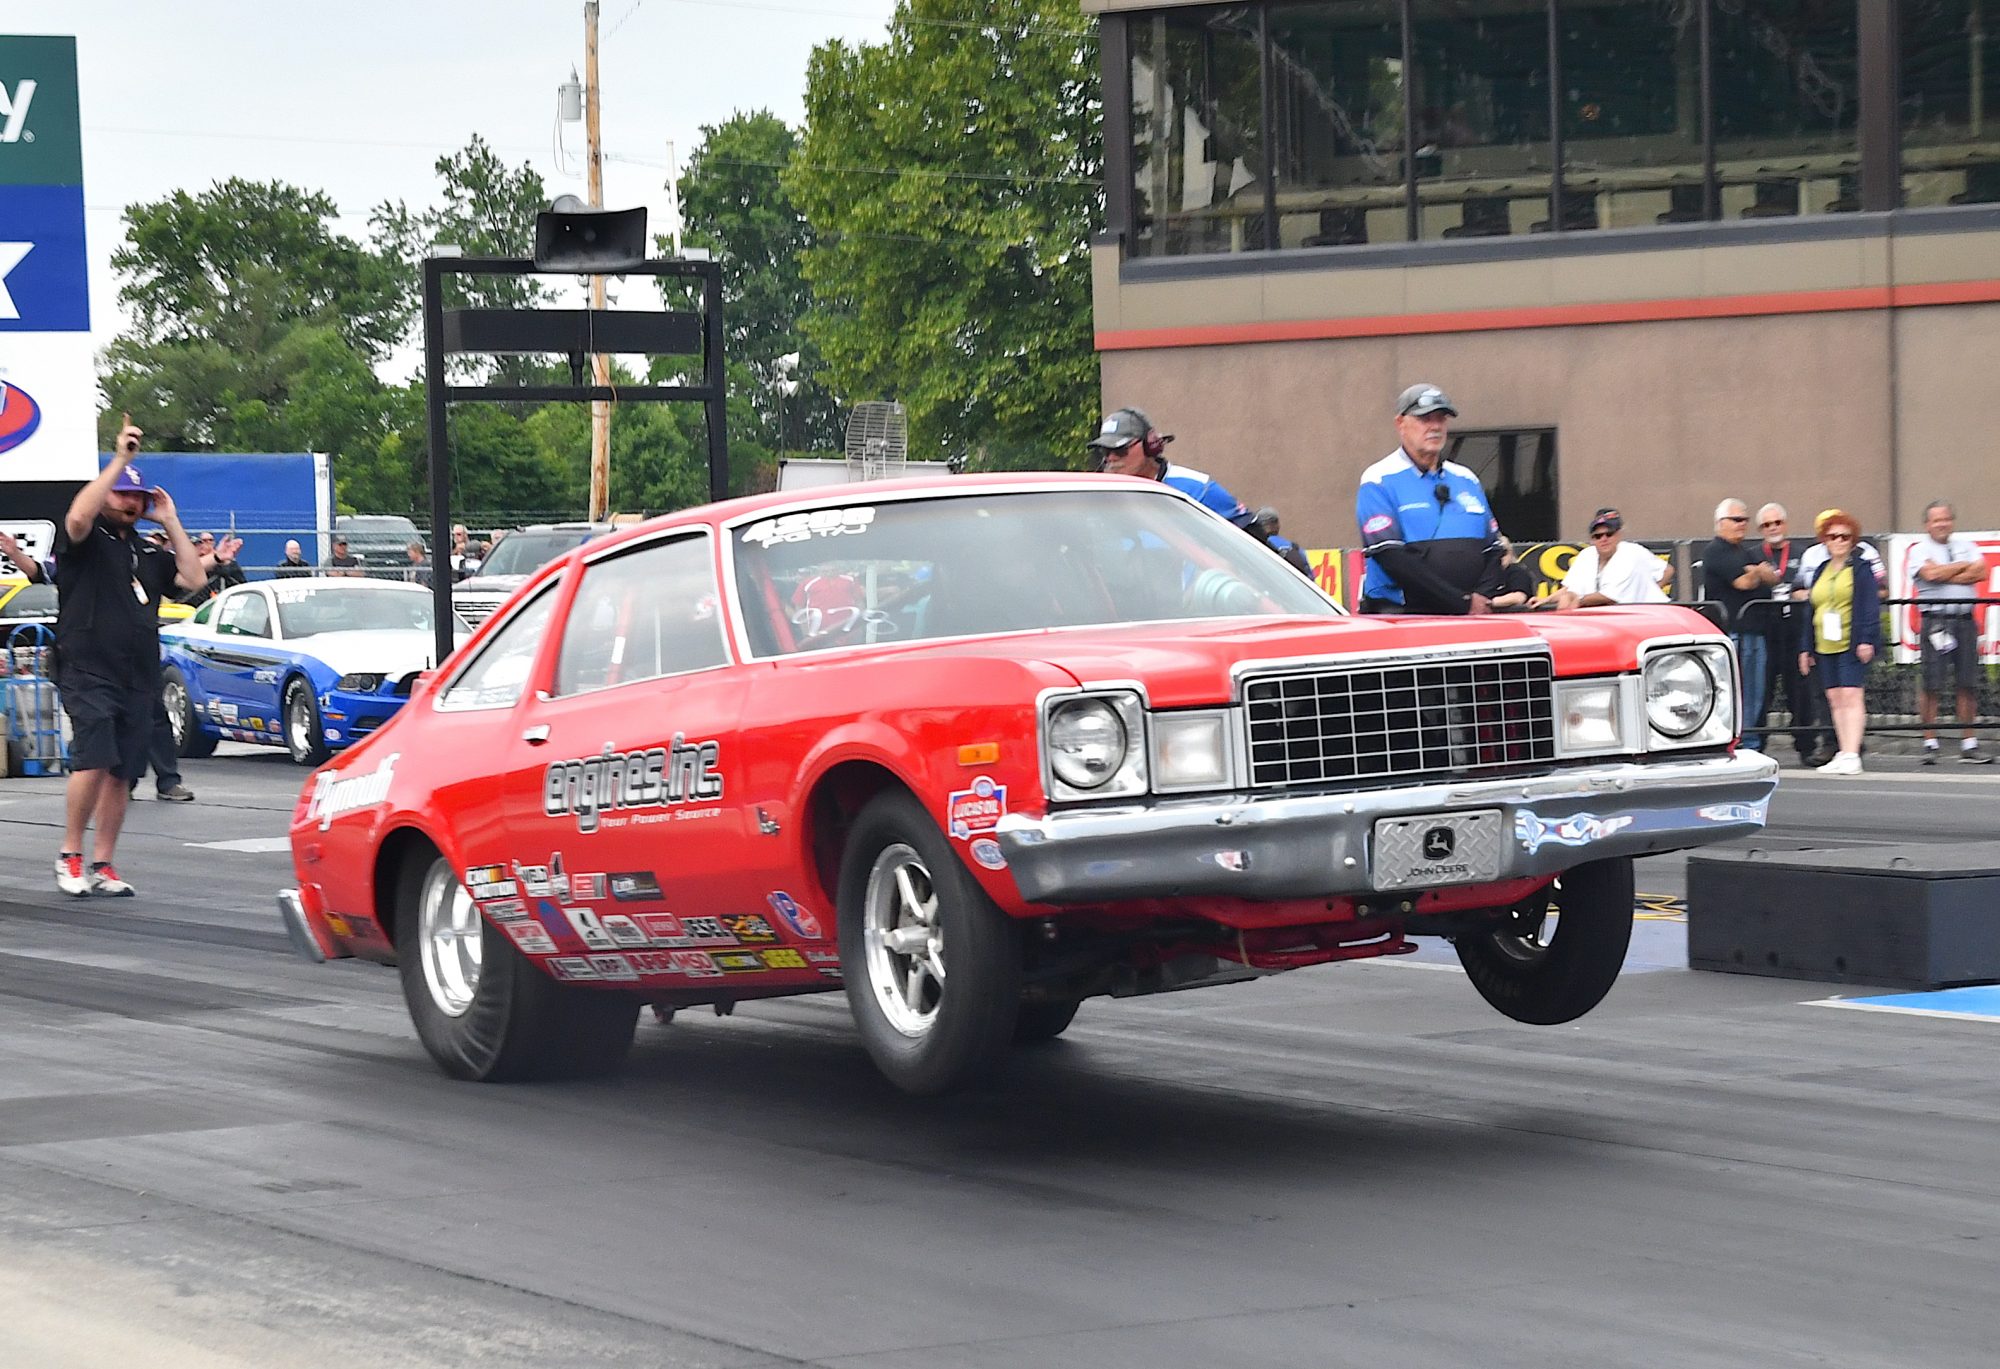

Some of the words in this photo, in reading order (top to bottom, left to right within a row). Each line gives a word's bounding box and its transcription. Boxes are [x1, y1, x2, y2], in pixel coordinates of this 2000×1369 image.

[306, 752, 401, 832] Plymouth
[1406, 867, 1434, 877] JOHN
[1435, 863, 1469, 874] DEERE
